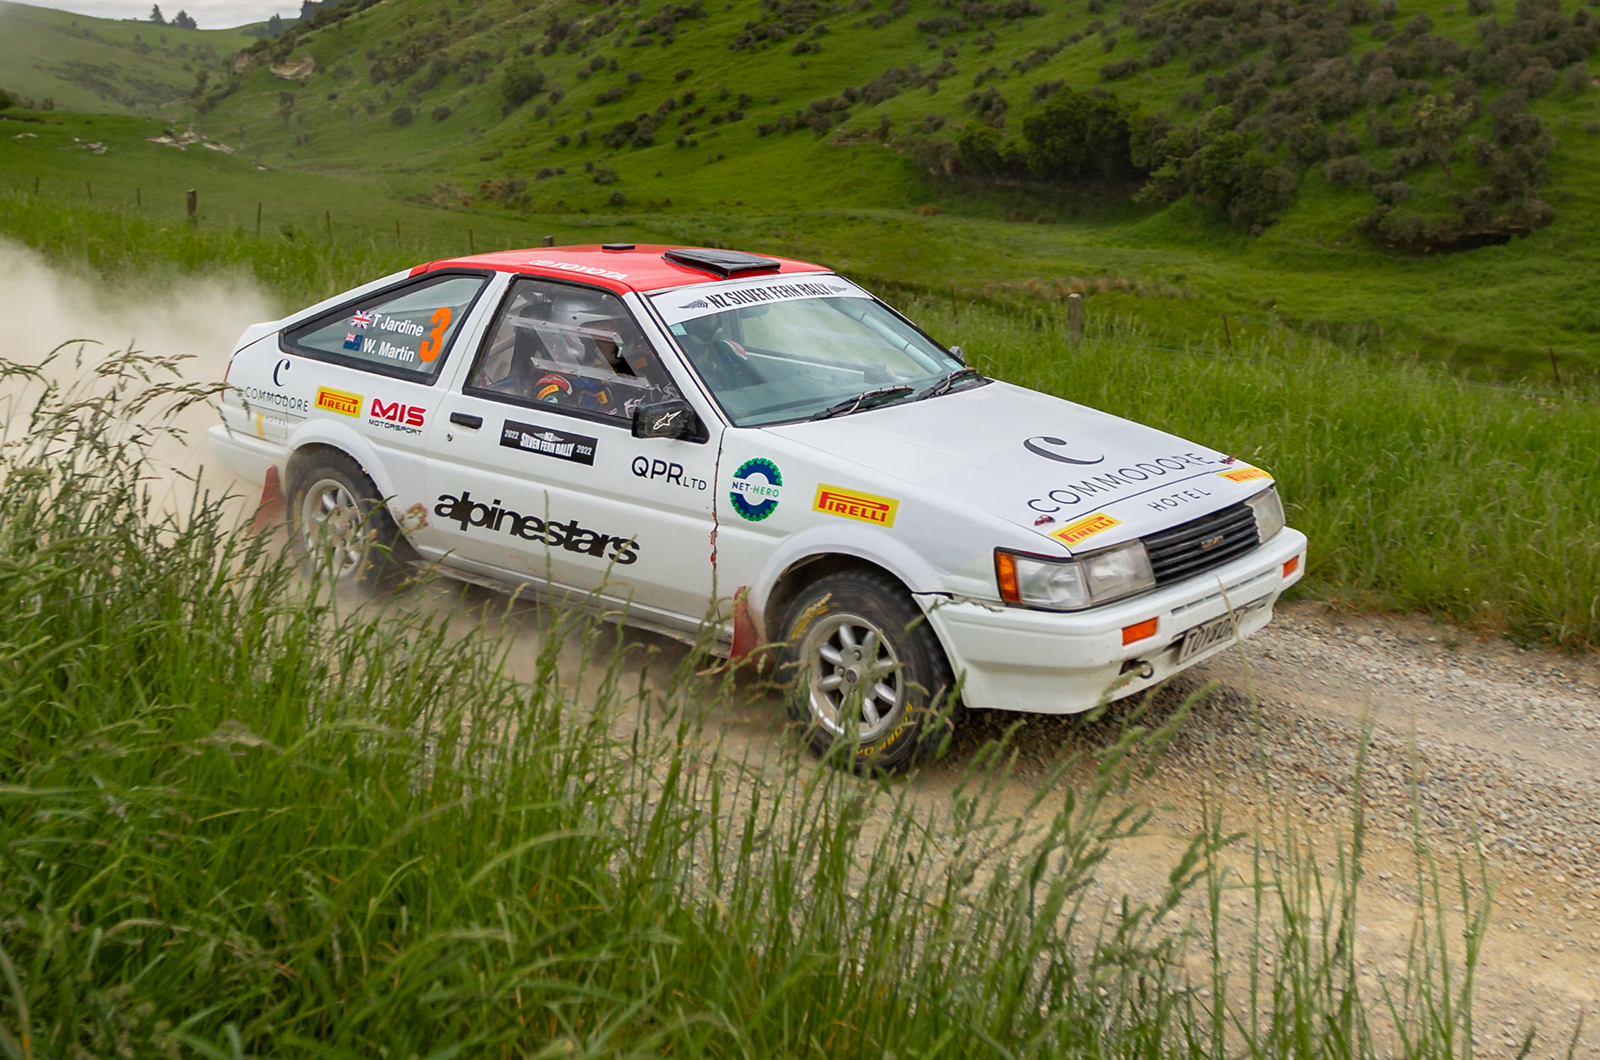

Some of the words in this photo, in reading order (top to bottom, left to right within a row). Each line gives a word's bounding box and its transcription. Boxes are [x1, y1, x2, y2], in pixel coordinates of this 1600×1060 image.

[550, 261, 629, 280] TOYOTA
[705, 294, 733, 309] NZ
[730, 289, 773, 305] SILVER
[766, 285, 804, 299] FERN
[799, 282, 834, 297] RALLY
[372, 313, 382, 328] T
[380, 316, 424, 337] Jardine
[420, 307, 452, 363] 3
[363, 337, 375, 354] W.
[378, 341, 415, 363] Martin
[273, 358, 291, 387] C
[245, 386, 309, 412] COMMODORE
[318, 391, 359, 414] PIRELLI
[370, 398, 427, 427] MIS
[368, 419, 422, 436] MOTORSPORT
[504, 429, 520, 440] 2022
[544, 431, 554, 441] NZ
[520, 432, 541, 450] SILVER
[540, 440, 556, 453] FERN
[555, 443, 575, 457] RALLY
[576, 444, 593, 456] 2022
[631, 455, 684, 486] QPR
[683, 476, 707, 491] LTD
[1027, 453, 1215, 513] COMMODORE
[731, 481, 780, 498] NET-HERO
[1146, 487, 1212, 512] HOTEL
[818, 490, 890, 523] PIRELLI
[433, 490, 641, 565] alpinestars
[1057, 516, 1116, 543] PIRELLI
